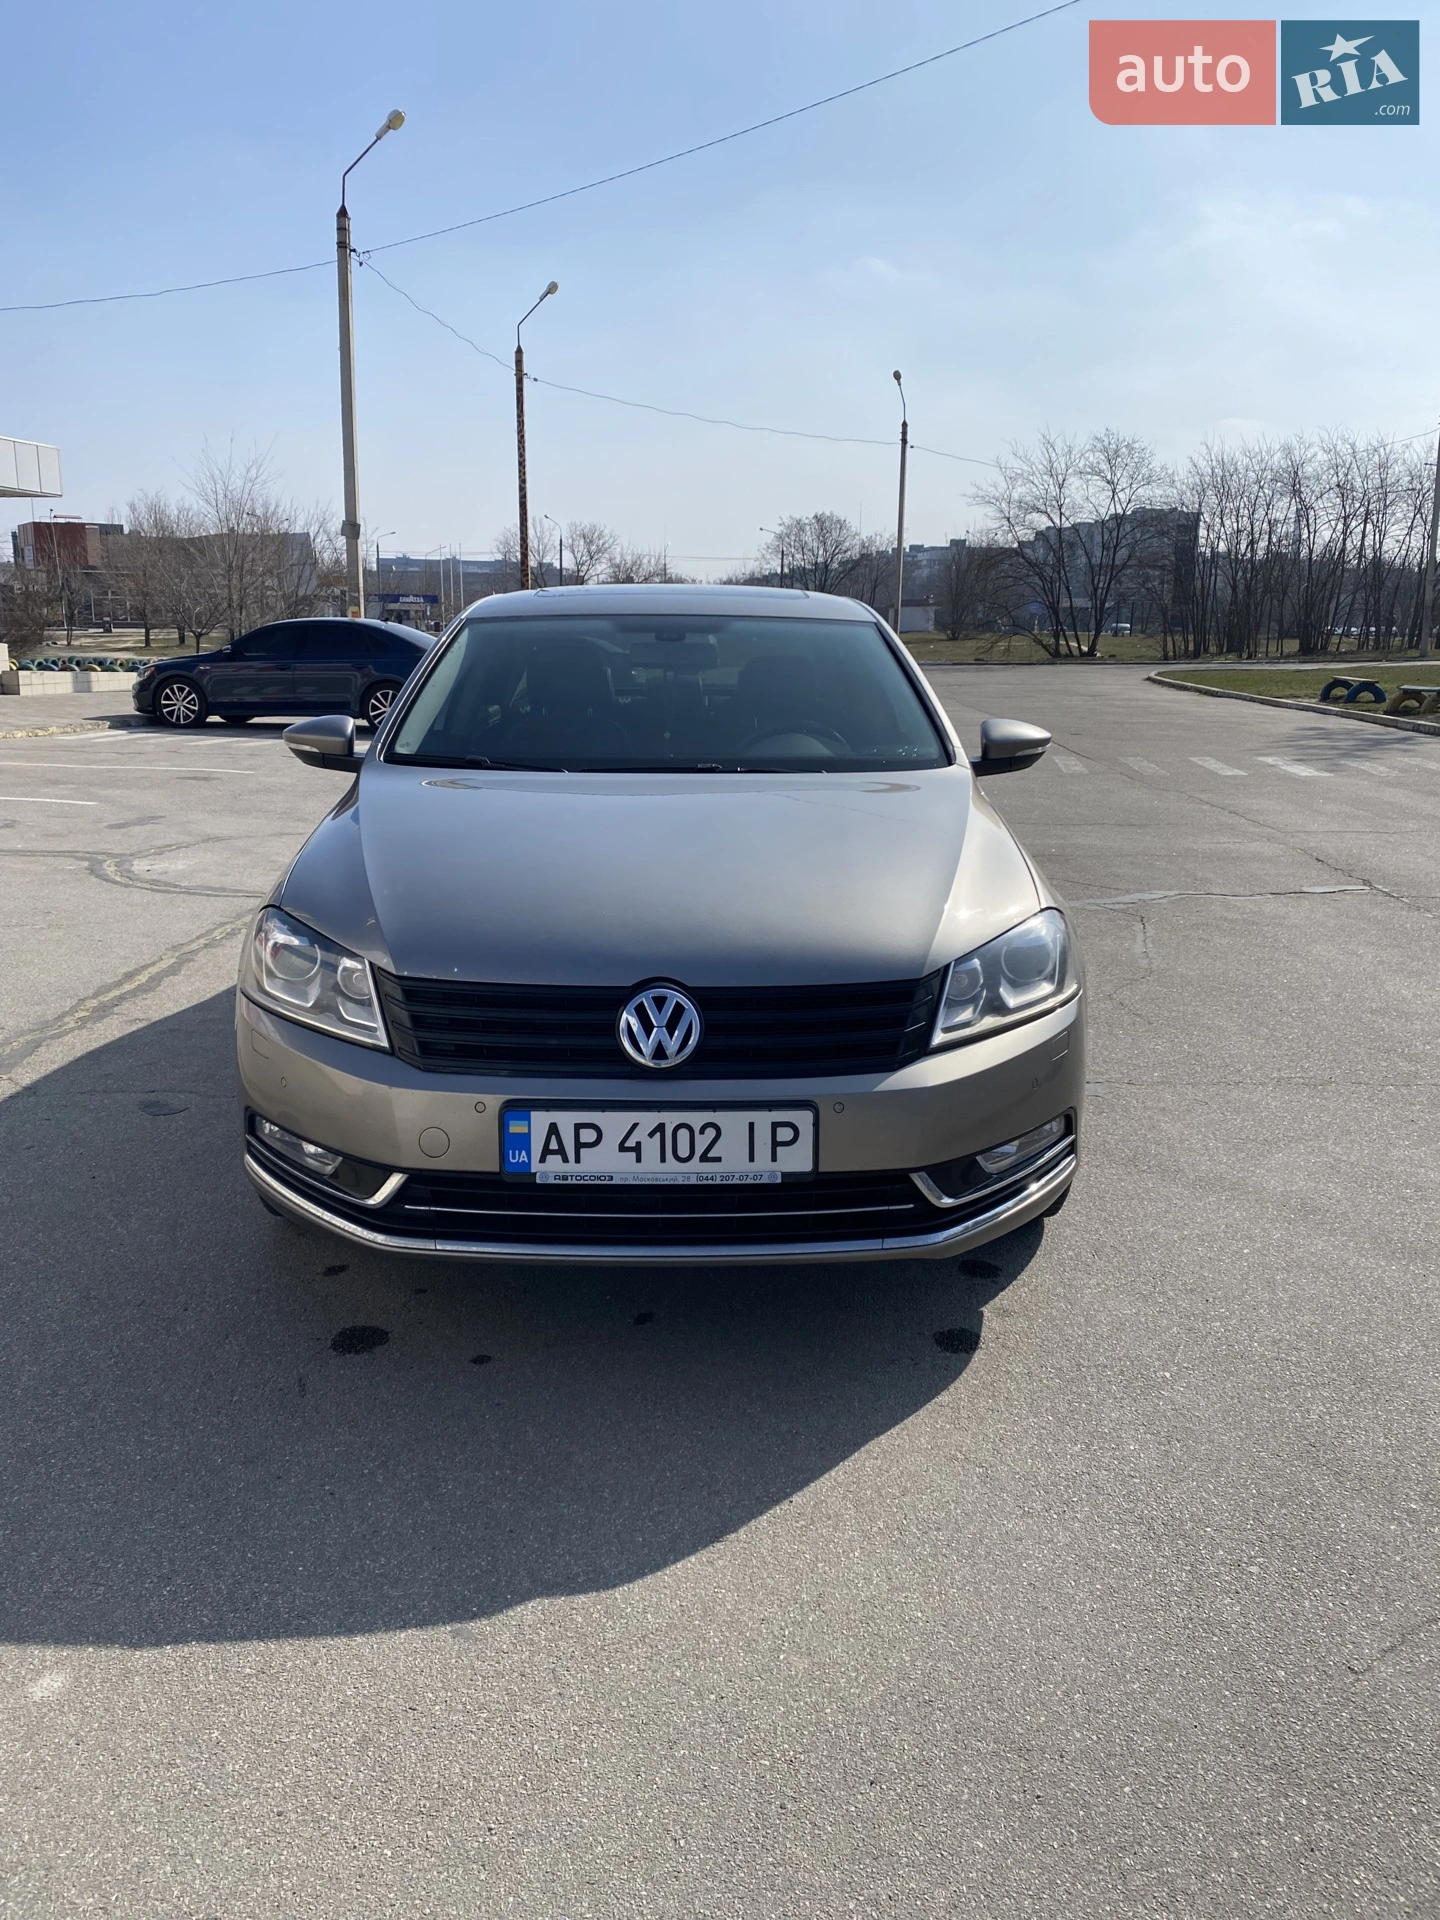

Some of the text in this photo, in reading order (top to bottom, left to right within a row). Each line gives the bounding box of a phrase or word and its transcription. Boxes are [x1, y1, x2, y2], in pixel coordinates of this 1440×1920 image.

[538, 1122, 603, 1164] AP
[617, 1122, 722, 1164] 4102
[509, 1150, 529, 1163] UA
[553, 1174, 614, 1182] АВТОСОЮЗ
[696, 1174, 717, 1183] (044)
[719, 1173, 764, 1182] 207-07-07
